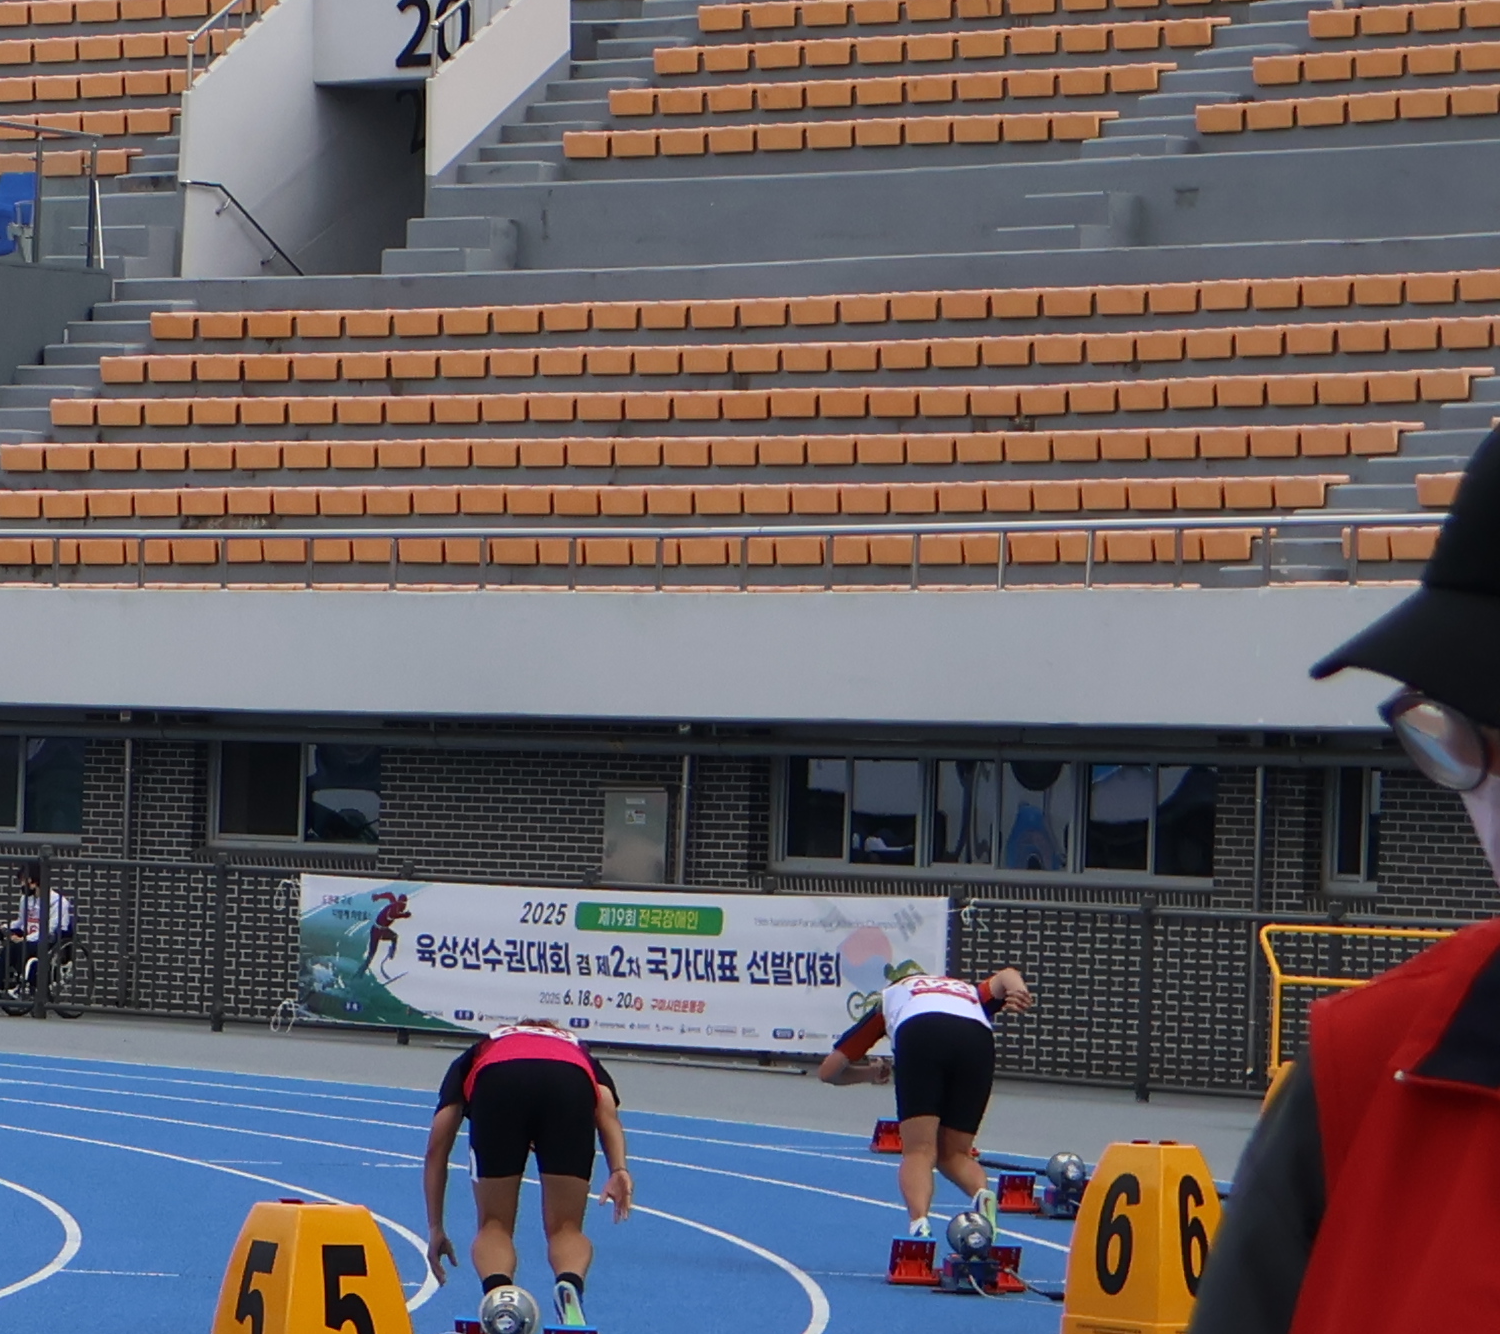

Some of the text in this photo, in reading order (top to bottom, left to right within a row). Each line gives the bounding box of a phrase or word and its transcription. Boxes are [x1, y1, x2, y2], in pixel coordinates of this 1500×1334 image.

[519, 901, 700, 930] 2025 제19회 전국장애인
[416, 933, 842, 987] 육상선수권대회 겸 제2차 국가대표 선발대회
[563, 989, 574, 1006] 6.
[1096, 1173, 1141, 1296] 6
[1178, 1174, 1209, 1298] 6
[499, 1290, 516, 1303] 5
